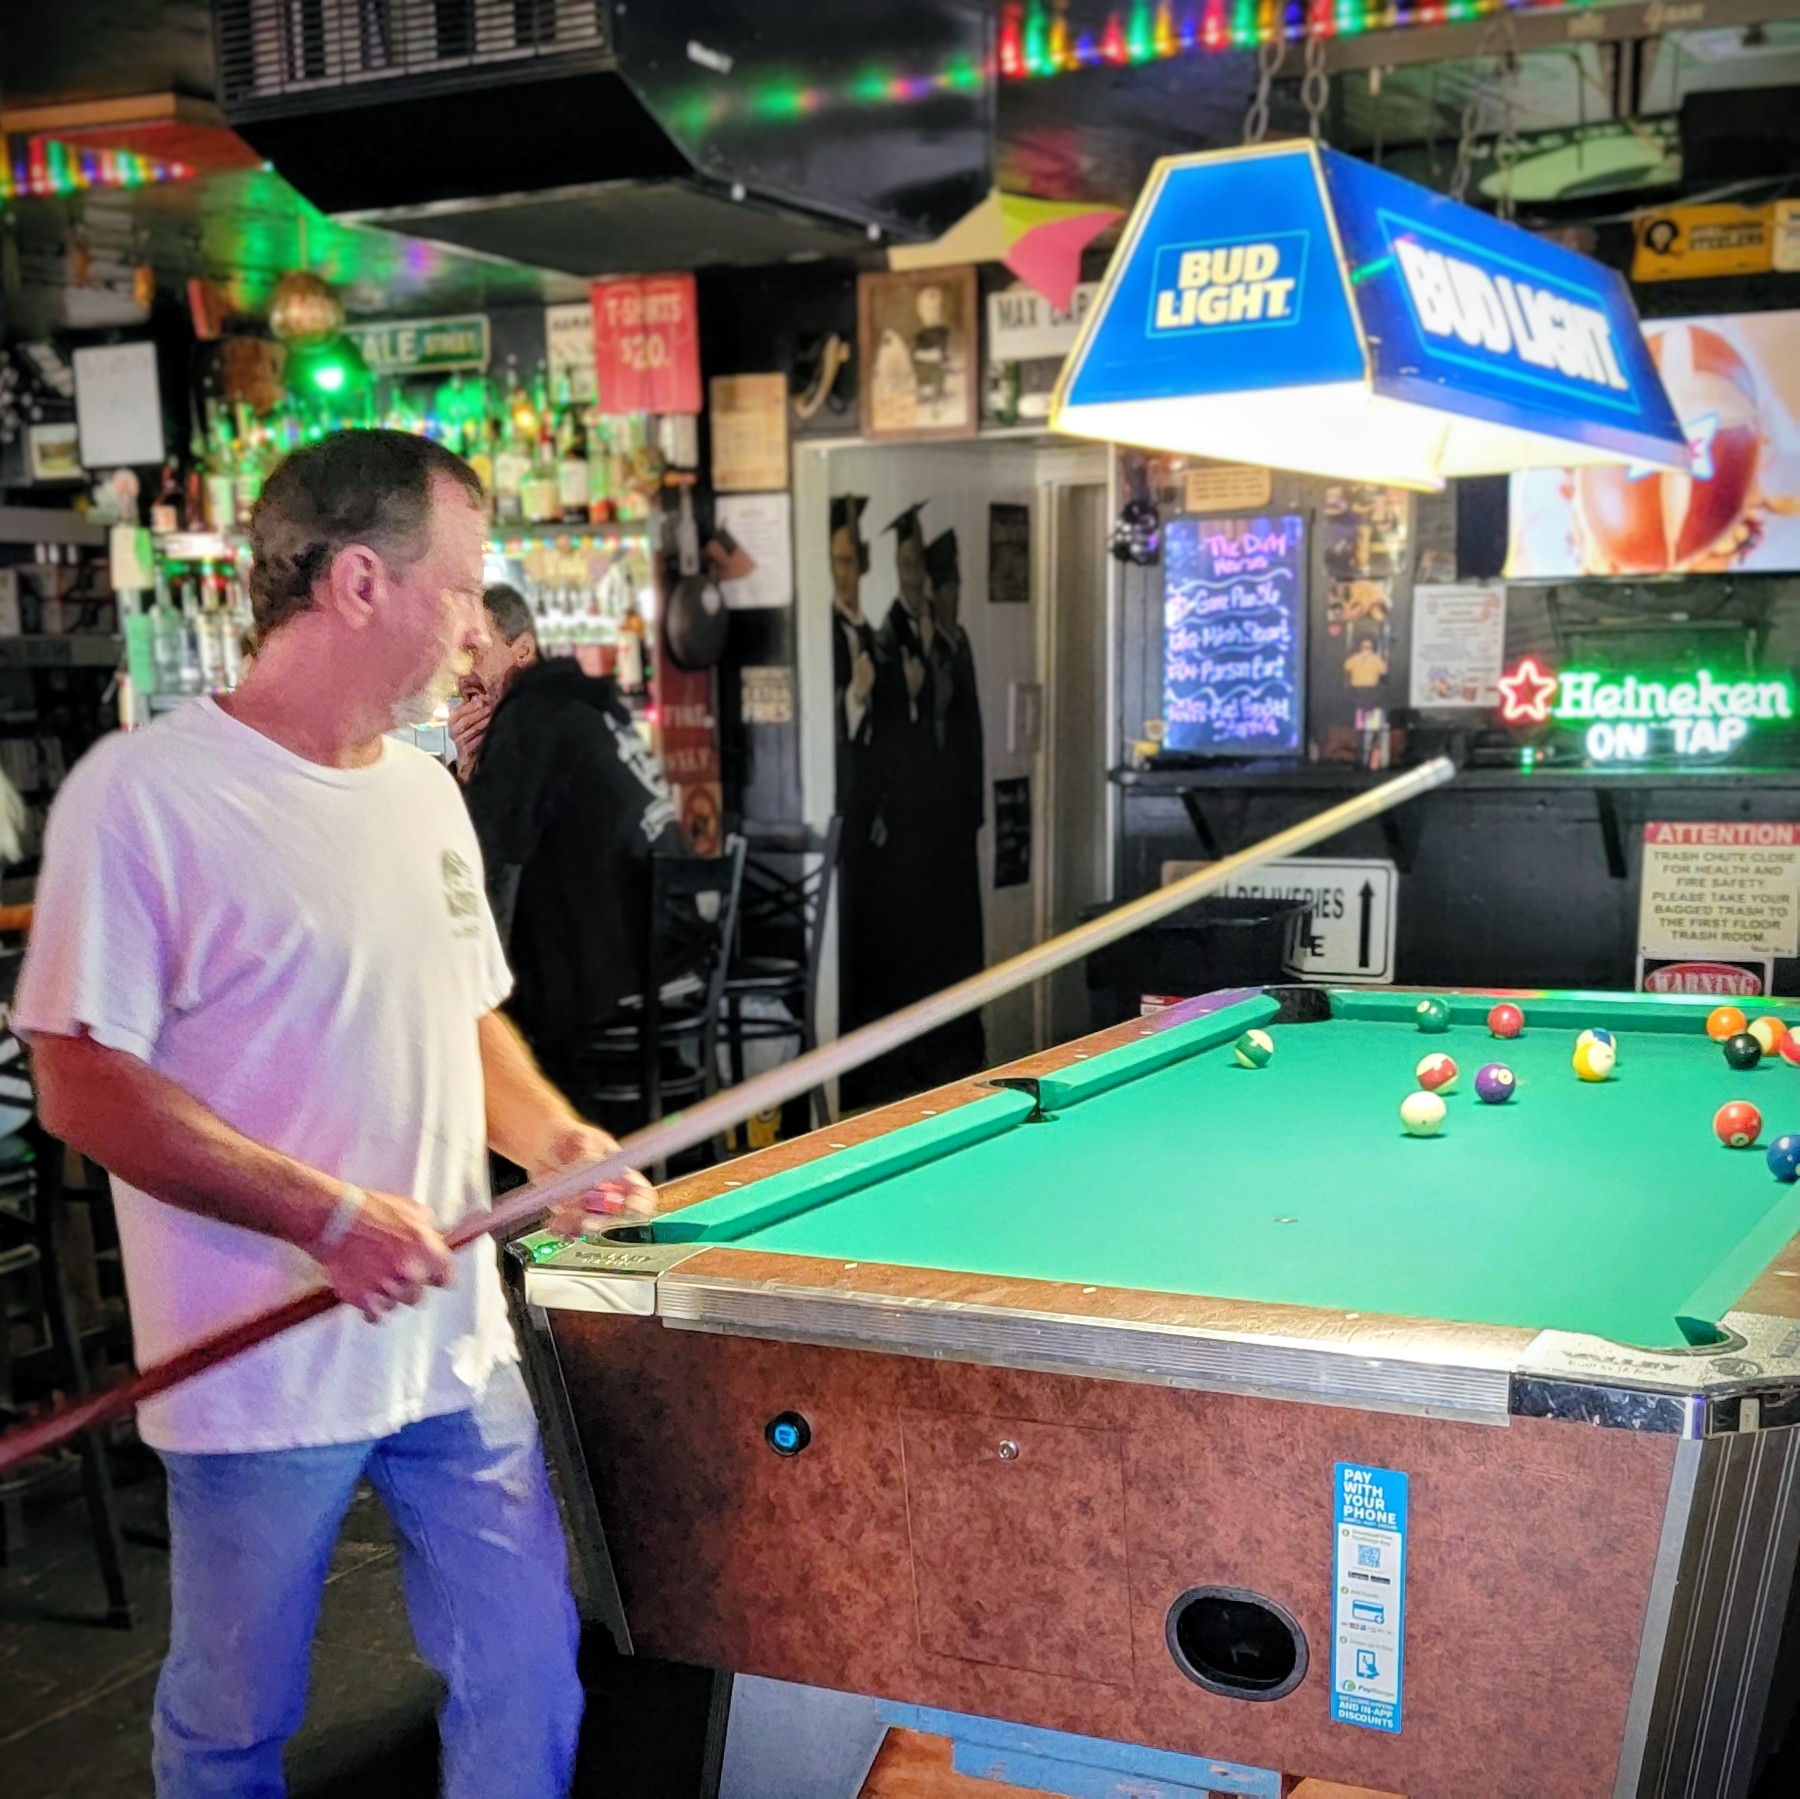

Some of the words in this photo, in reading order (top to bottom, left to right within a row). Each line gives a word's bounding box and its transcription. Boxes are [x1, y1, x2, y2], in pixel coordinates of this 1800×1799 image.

[1178, 244, 1279, 289] BUD
[1155, 279, 1295, 329] LIGHT
[1394, 238, 1512, 354] BUD
[1494, 274, 1629, 391] LIGHT
[1555, 670, 1792, 718] Heineken
[1586, 722, 1648, 759] ON
[1669, 717, 1747, 753] TAP
[1657, 824, 1794, 845] ATTENTION
[1653, 852, 1699, 861] TRASH
[1703, 852, 1746, 862] CHUTE
[1750, 853, 1796, 863] CLOSE
[1662, 864, 1691, 873] FOR
[1695, 865, 1749, 875] HEALTH
[1753, 866, 1784, 876] AND
[1676, 878, 1706, 887] FIRE
[1652, 892, 1706, 902] PLEASE
[1711, 893, 1746, 904] TAKE
[1751, 894, 1790, 904] YOUR
[1653, 904, 1713, 915] BAGGED
[1718, 906, 1763, 917] TRASH
[1767, 907, 1788, 918] TO
[1659, 917, 1684, 927] THE
[1689, 918, 1728, 928] FIRST
[1732, 919, 1781, 930] FLOOR
[1671, 930, 1717, 940] TRASH
[1343, 1468, 1372, 1484] PAY
[1343, 1480, 1383, 1499] WITH
[1343, 1493, 1385, 1511] YOUR
[1343, 1505, 1397, 1524] PHONE
[1338, 1701, 1359, 1712] AND
[1360, 1704, 1394, 1718] IN-APP
[1338, 1709, 1394, 1728] DISCOUNTS
